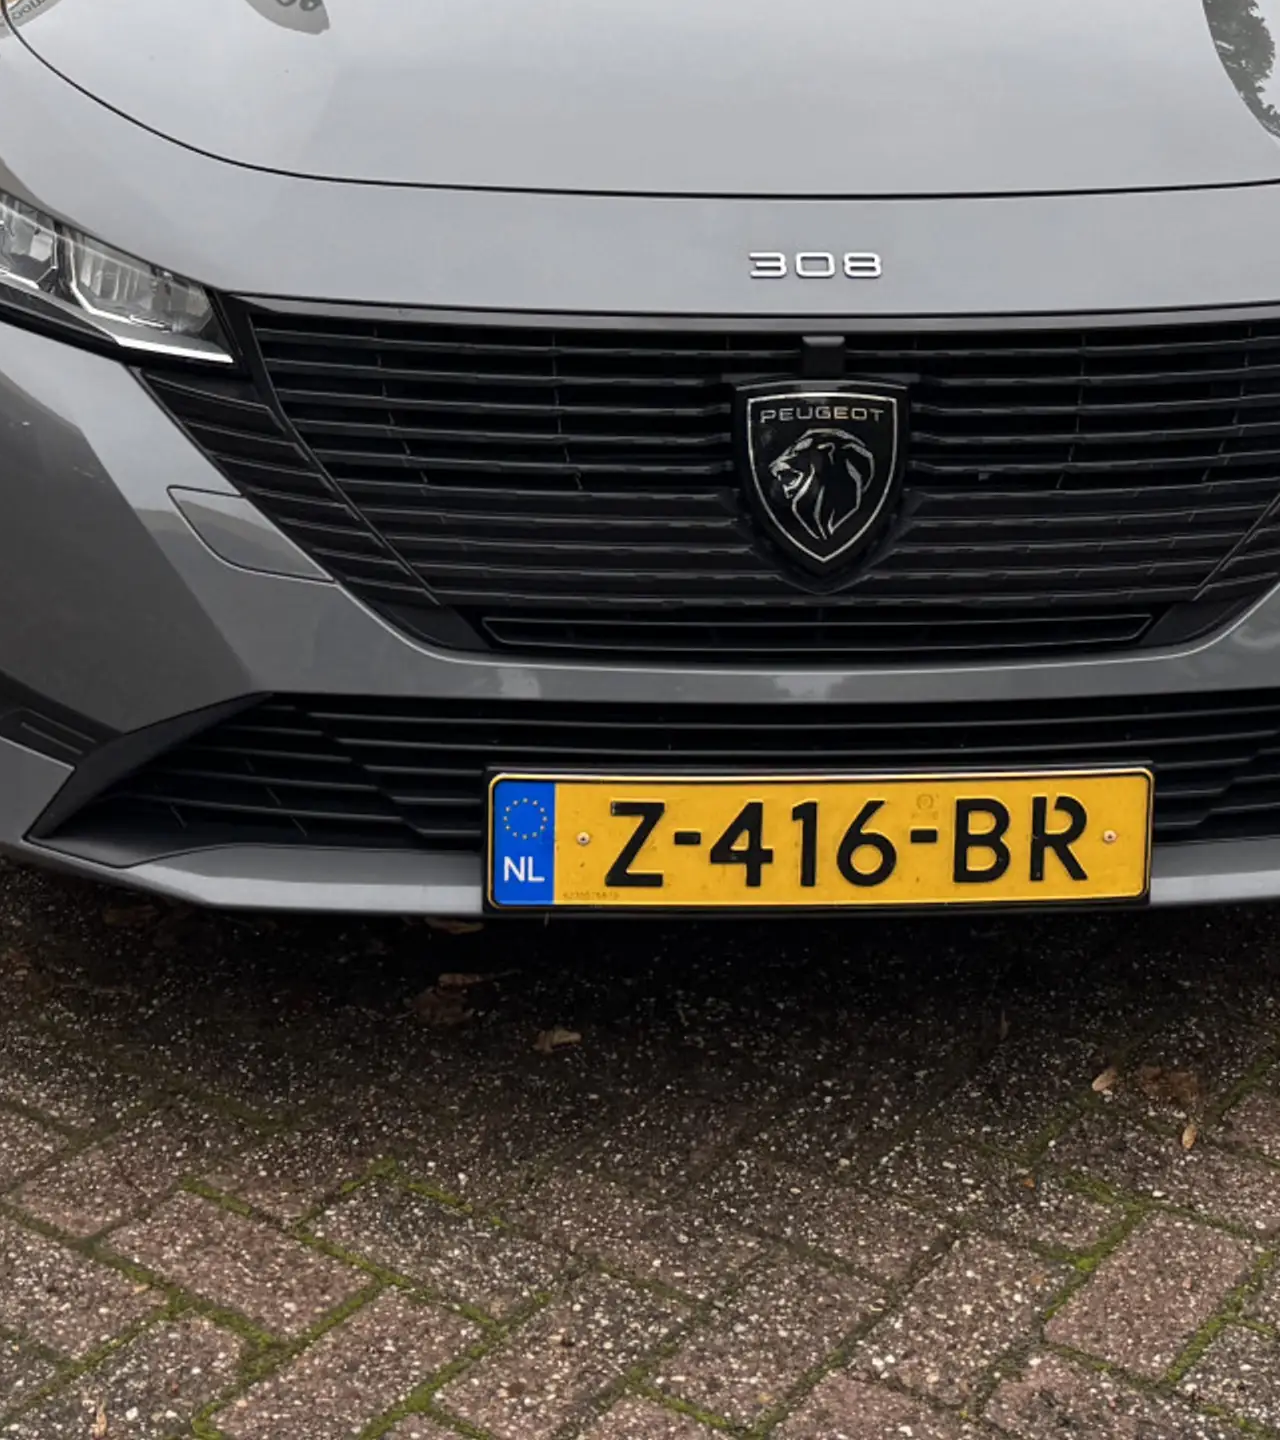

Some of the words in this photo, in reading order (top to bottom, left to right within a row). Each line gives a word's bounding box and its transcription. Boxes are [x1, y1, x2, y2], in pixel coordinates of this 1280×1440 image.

[749, 252, 882, 278] 308
[760, 406, 884, 423] PEUGEOT
[503, 856, 545, 882] NL
[605, 796, 1088, 887] Z-416-BR
